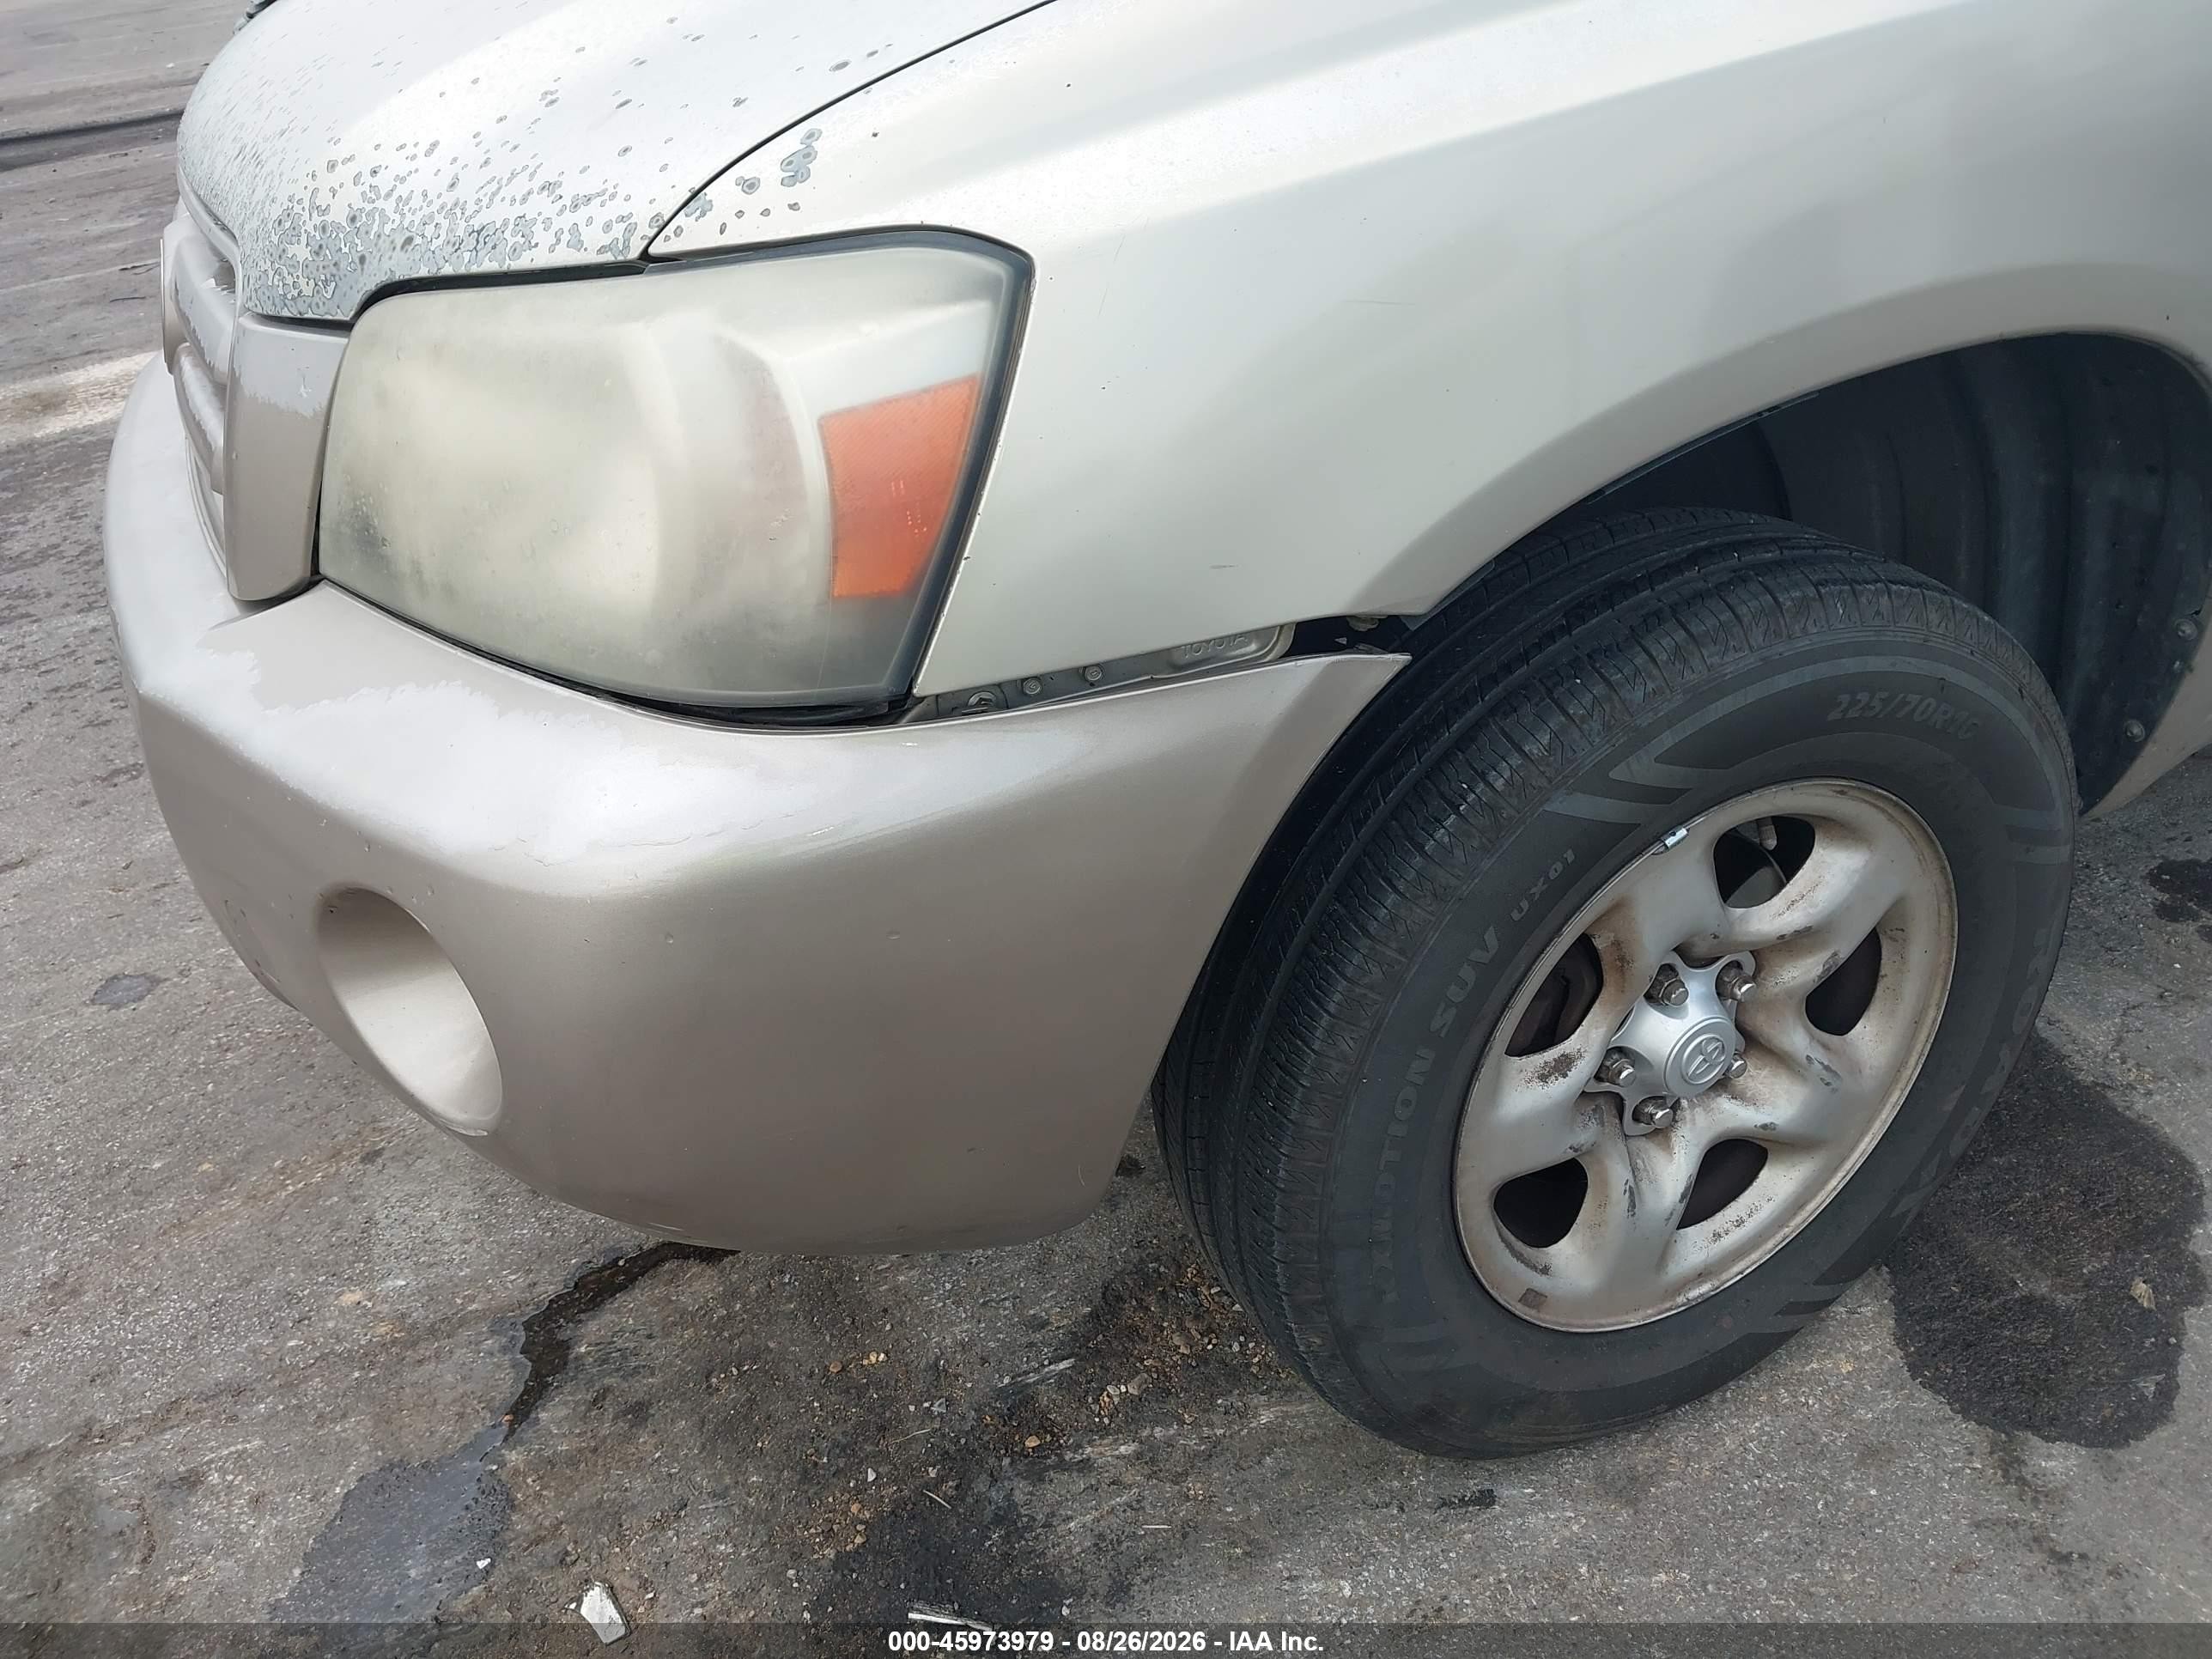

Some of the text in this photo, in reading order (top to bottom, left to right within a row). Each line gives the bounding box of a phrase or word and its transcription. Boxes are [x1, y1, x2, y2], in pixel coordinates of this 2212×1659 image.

[1180, 637, 1249, 659] TOYOTA
[1429, 925, 1501, 1038] SUV
[1510, 847, 1578, 923] UX01
